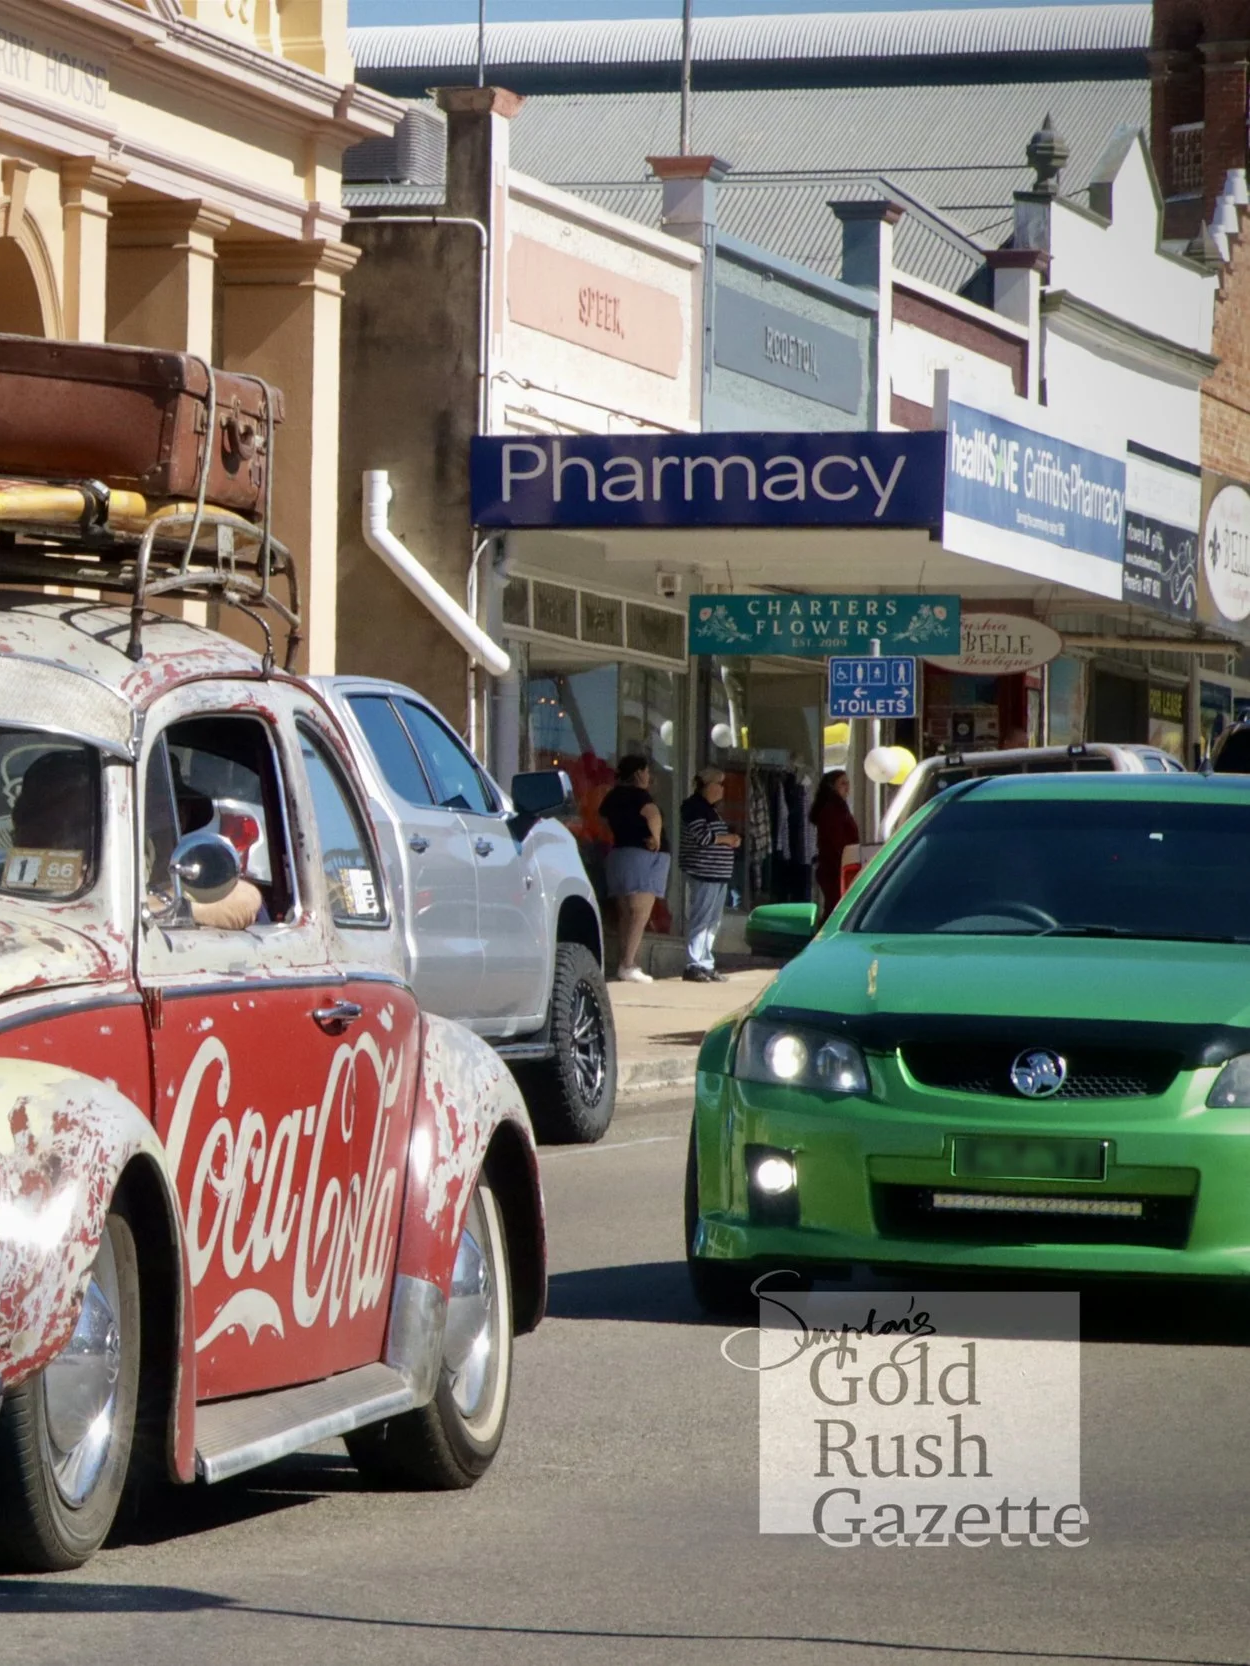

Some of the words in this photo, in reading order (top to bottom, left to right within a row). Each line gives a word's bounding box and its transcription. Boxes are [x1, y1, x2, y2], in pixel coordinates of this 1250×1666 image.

[45, 47, 108, 110] HOUSE
[501, 440, 907, 517] Pharmacy
[1023, 447, 1070, 511] Griffiths
[1070, 463, 1125, 540] Pharmacy
[747, 600, 897, 616] CHARTERS
[756, 620, 888, 636] FLOWERS
[962, 631, 1035, 655] BELLE
[838, 699, 907, 713] TOILETS
[165, 1031, 404, 1329] Coca-Cola
